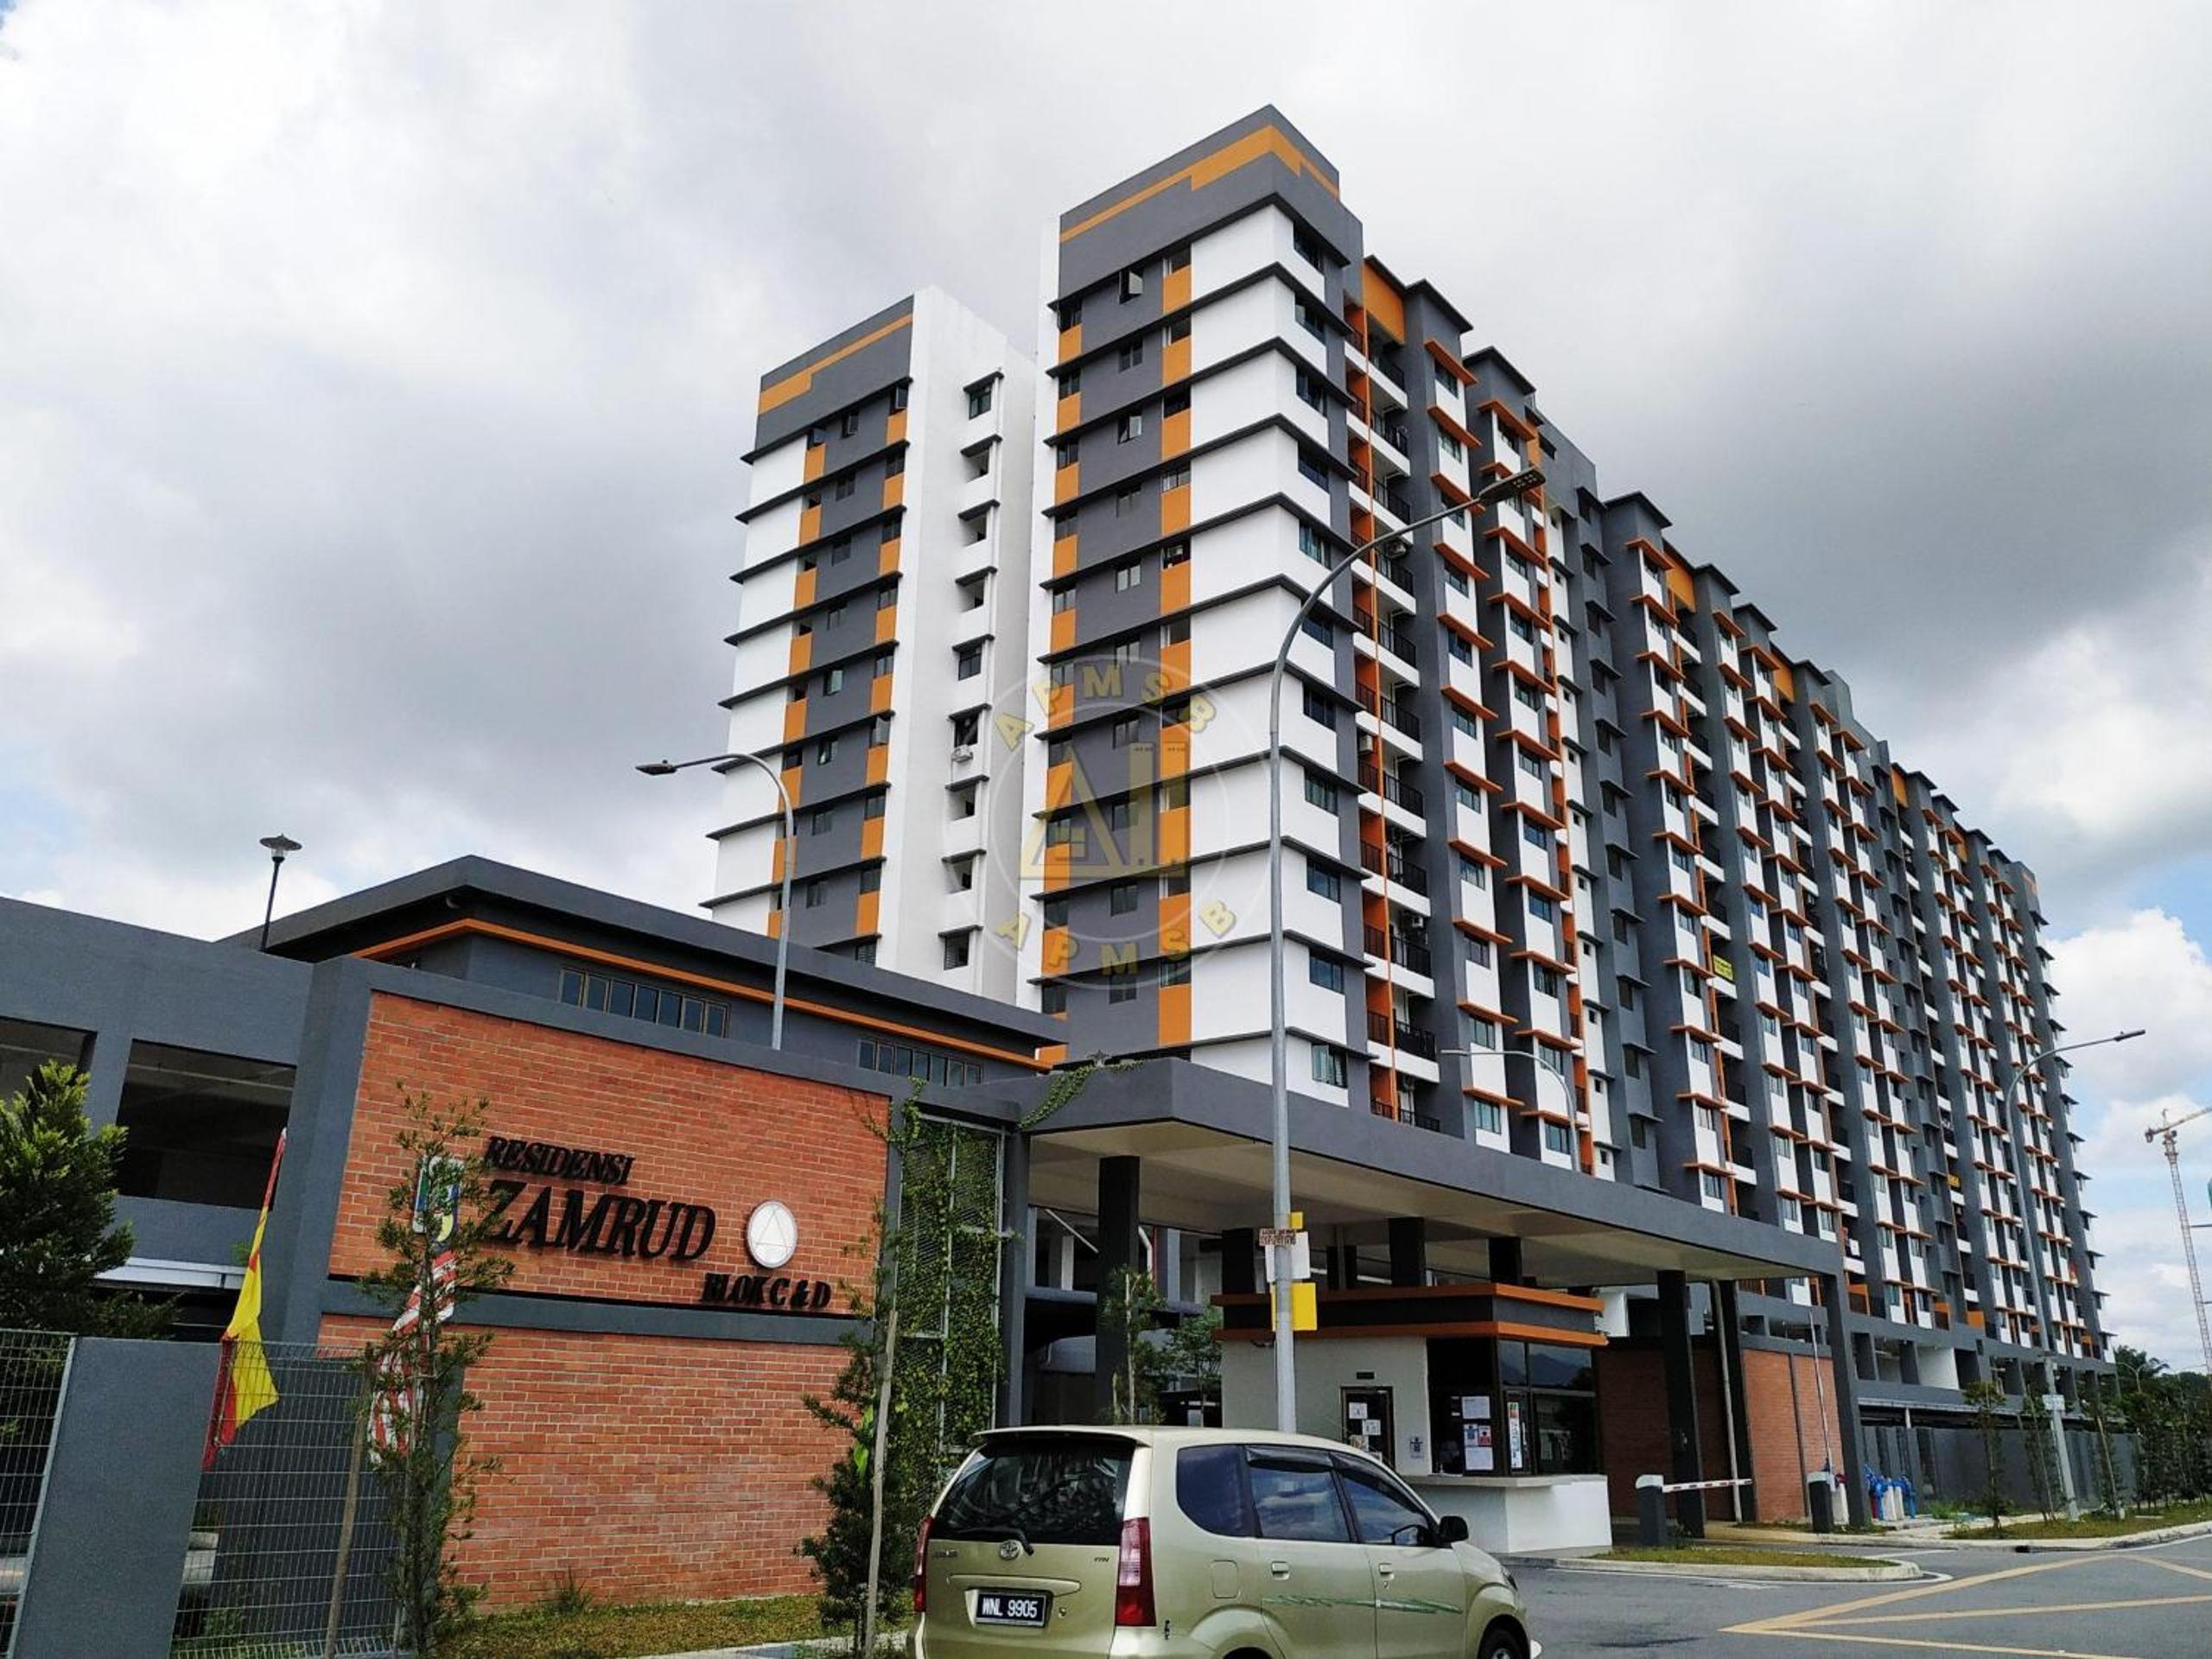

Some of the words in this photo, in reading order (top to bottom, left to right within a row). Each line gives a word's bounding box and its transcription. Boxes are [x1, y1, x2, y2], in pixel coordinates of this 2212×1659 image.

[483, 1135, 636, 1185] RESIDENSI
[477, 1179, 715, 1260] ZAMRUD
[701, 1273, 771, 1305] BLOK
[769, 1277, 791, 1306] C
[810, 1281, 832, 1309] D
[982, 1596, 1004, 1617] WNL
[1007, 1599, 1038, 1618] 9905
